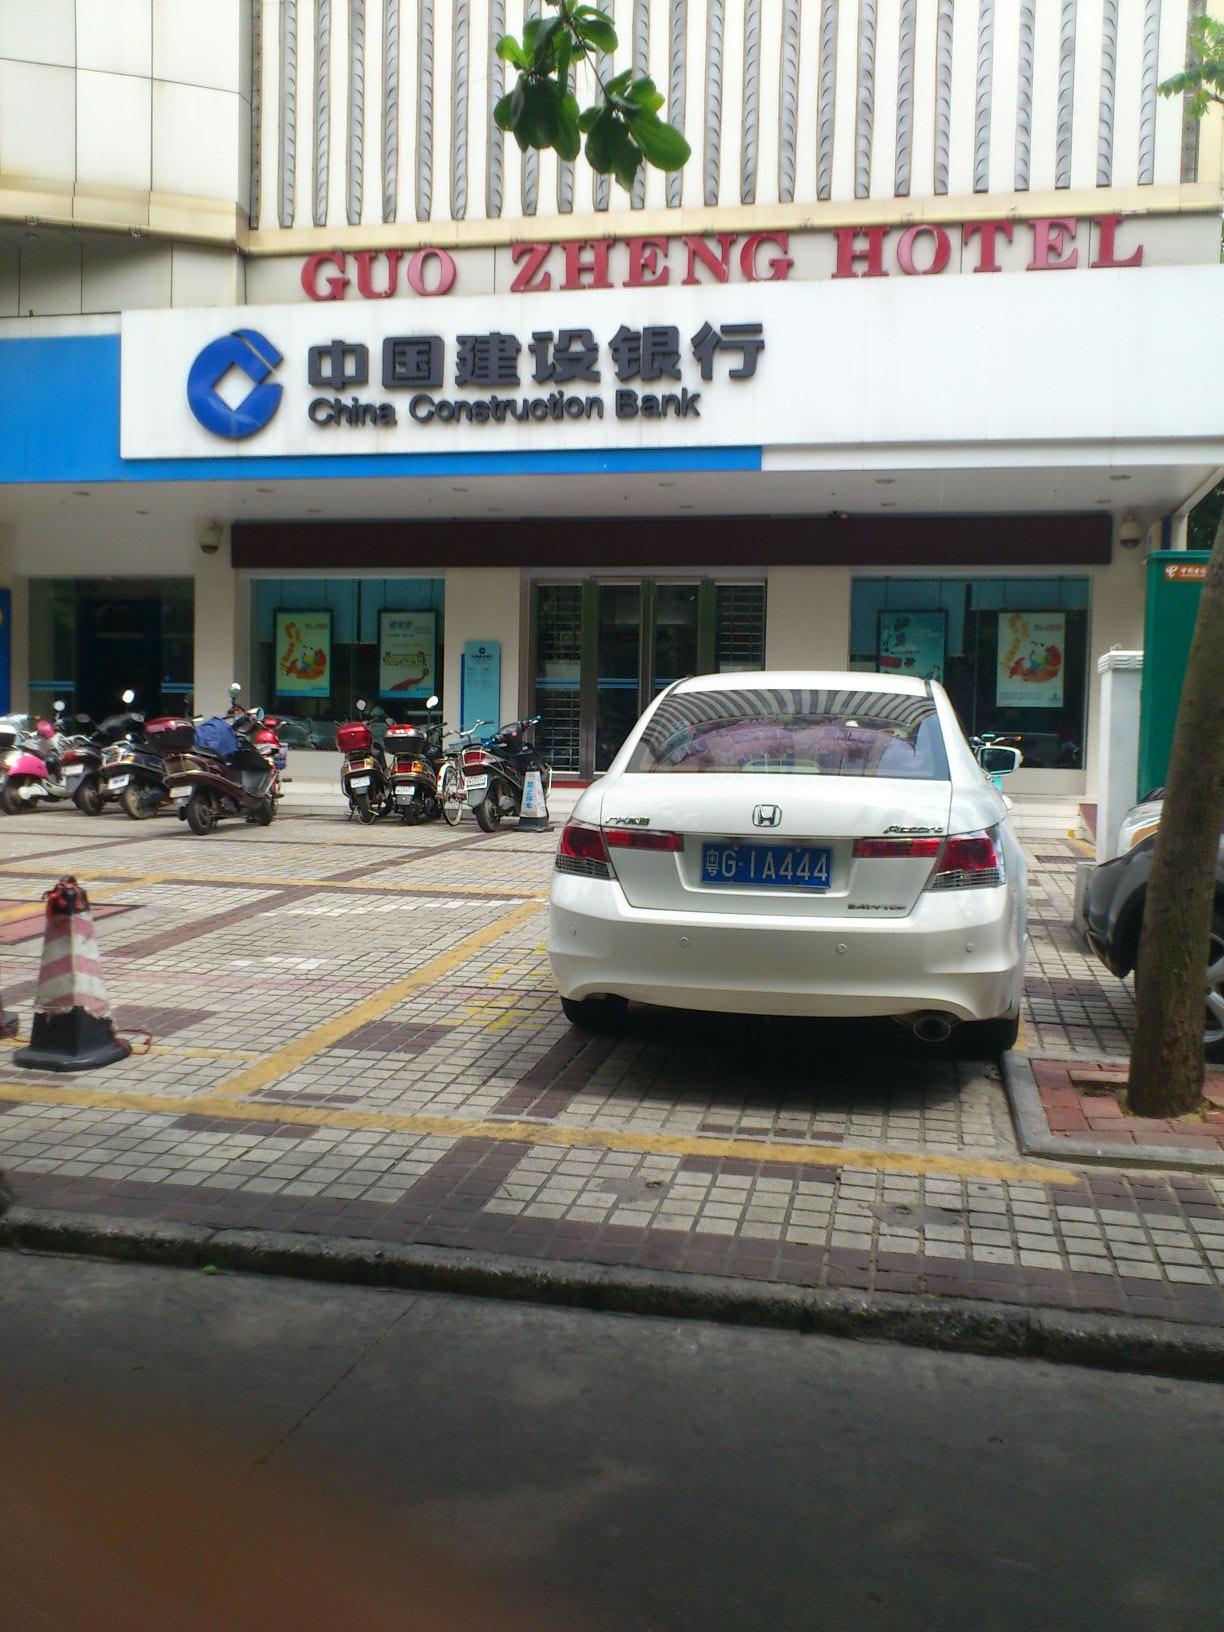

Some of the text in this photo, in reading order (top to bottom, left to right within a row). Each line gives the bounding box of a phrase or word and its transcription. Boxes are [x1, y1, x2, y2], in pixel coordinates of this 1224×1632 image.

[301, 214, 1144, 301] GUO ZHENG HOTEL
[308, 320, 765, 391] 中国建设银行
[308, 387, 701, 426] China Construction Bank
